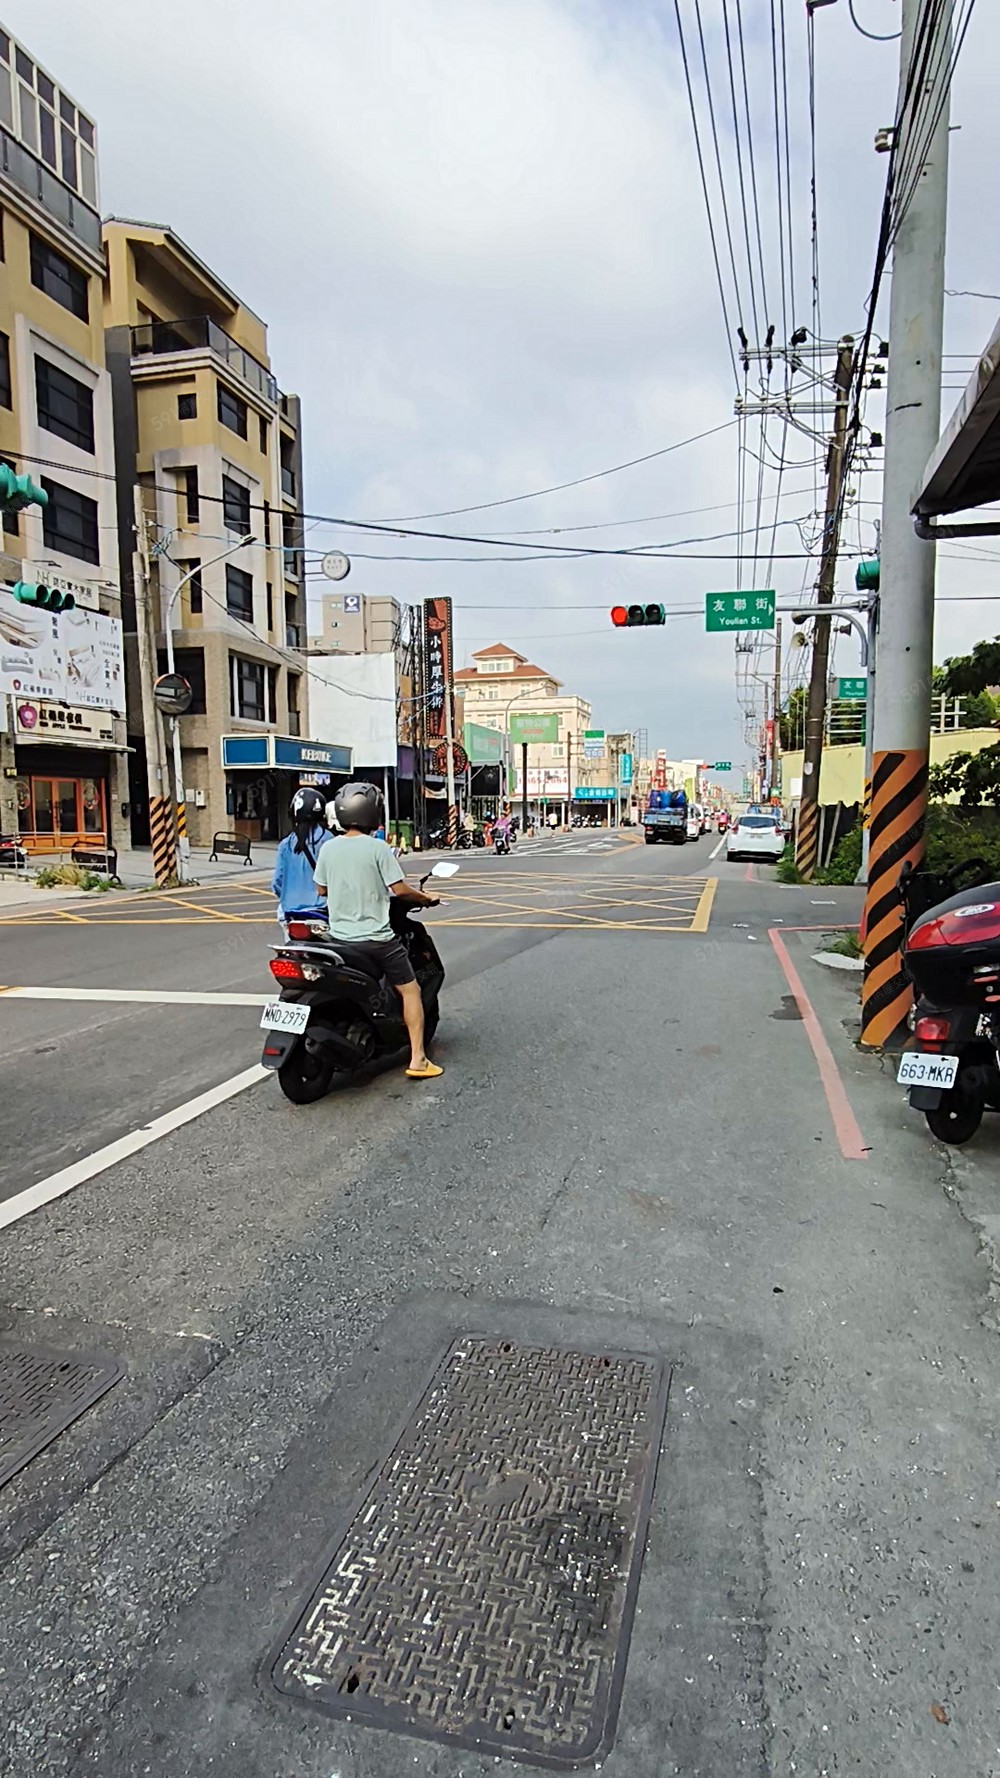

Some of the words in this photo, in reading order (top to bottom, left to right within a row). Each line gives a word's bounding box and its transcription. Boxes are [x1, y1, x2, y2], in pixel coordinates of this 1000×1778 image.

[713, 597, 769, 612] 友聯街
[719, 617, 748, 626] Youlian
[751, 616, 763, 625] St.
